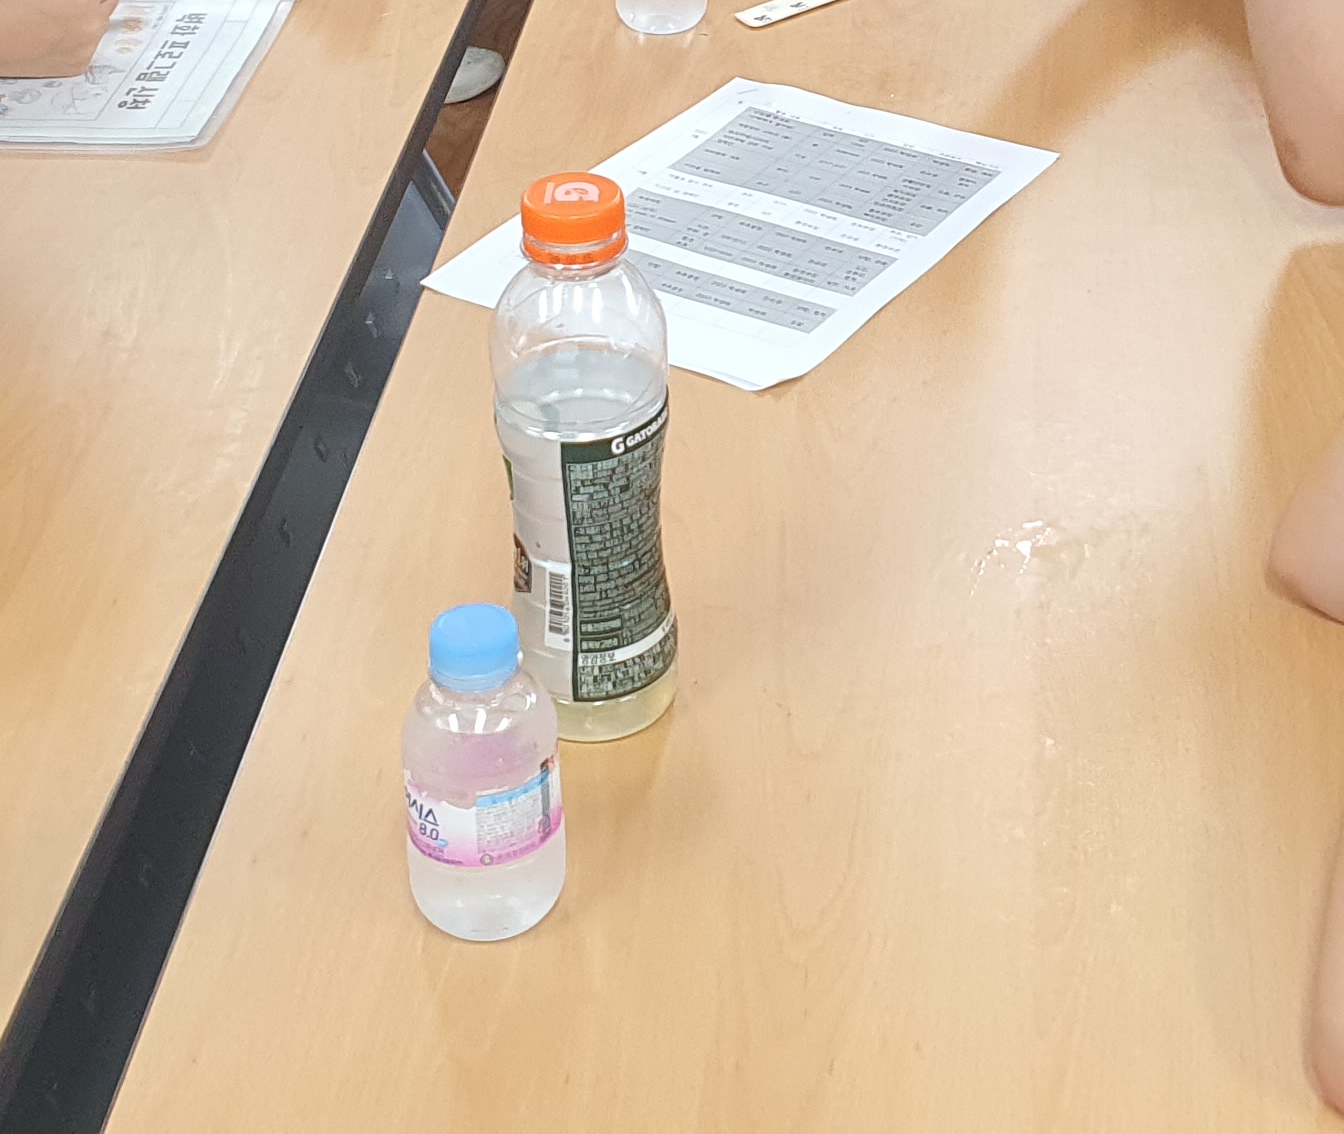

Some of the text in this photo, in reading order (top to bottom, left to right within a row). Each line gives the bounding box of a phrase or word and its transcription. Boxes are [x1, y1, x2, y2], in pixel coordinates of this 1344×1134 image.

[171, 13, 208, 36] 벽화
[135, 40, 190, 82] 프로그램
[117, 86, 159, 110] 신청
